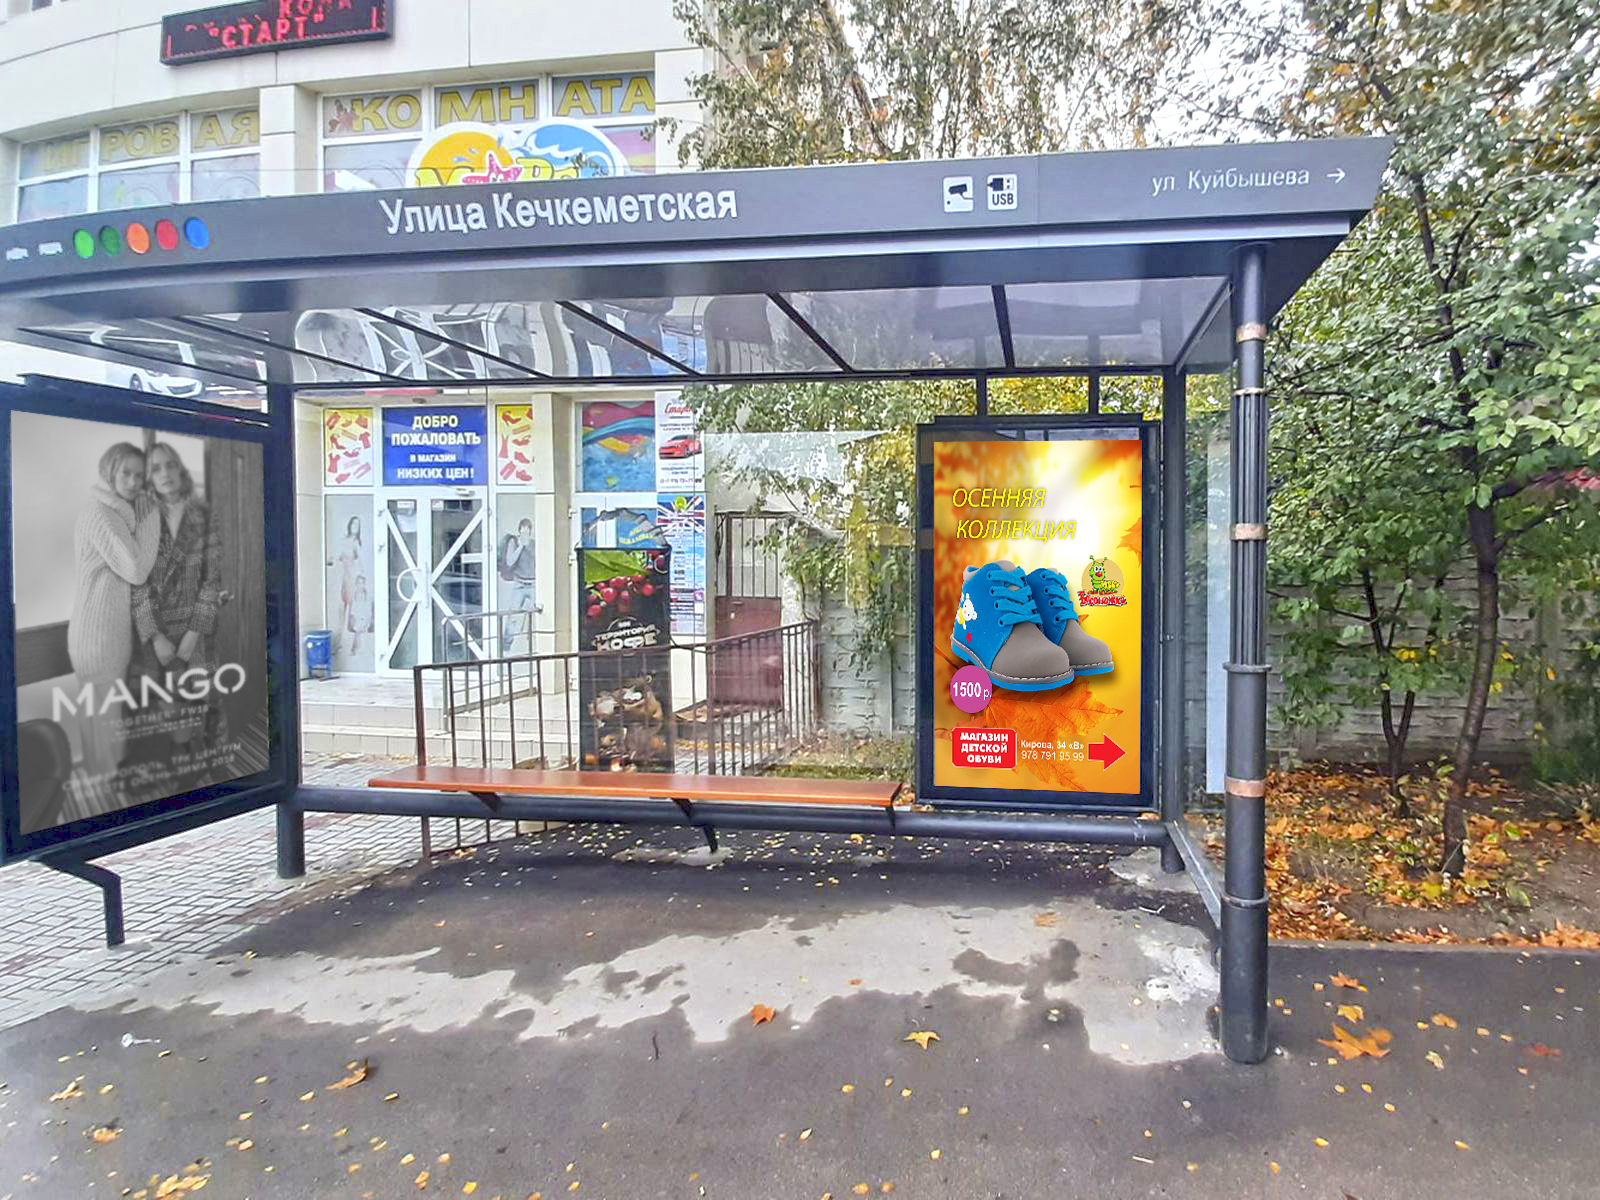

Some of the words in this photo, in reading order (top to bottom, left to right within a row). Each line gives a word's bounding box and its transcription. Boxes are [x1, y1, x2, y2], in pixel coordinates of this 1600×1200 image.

[1188, 168, 1310, 194] Куйбышева
[992, 193, 1014, 206] USB
[378, 198, 488, 235] Улица
[492, 189, 738, 230] Кечкеметская
[412, 415, 459, 430] ДОБРО
[391, 432, 481, 446] ПОЖАЛОВАТЬ
[410, 454, 416, 462] В
[417, 454, 457, 462] МАГАЗИН
[397, 467, 443, 479] НИЗКИХ
[446, 467, 475, 480] ЦЕН!
[952, 488, 1046, 508] ОСЕННЯЯ
[956, 519, 1077, 543] КОЛЛЕКЦИЯ
[52, 663, 246, 722] MANGO
[952, 682, 981, 697] 1500
[983, 688, 992, 700] р.
[960, 732, 1009, 742] МАГАЗИН
[960, 742, 1008, 753] ДЕТСКОЙ
[1020, 740, 1054, 750] Кирова,
[1056, 741, 1066, 749] 34
[1068, 742, 1085, 750] «В»
[966, 755, 1002, 764] ОБУВИ
[1021, 750, 1038, 760] 978
[1040, 750, 1056, 760] 791
[1059, 751, 1071, 761] 95
[1072, 752, 1085, 761] 99
